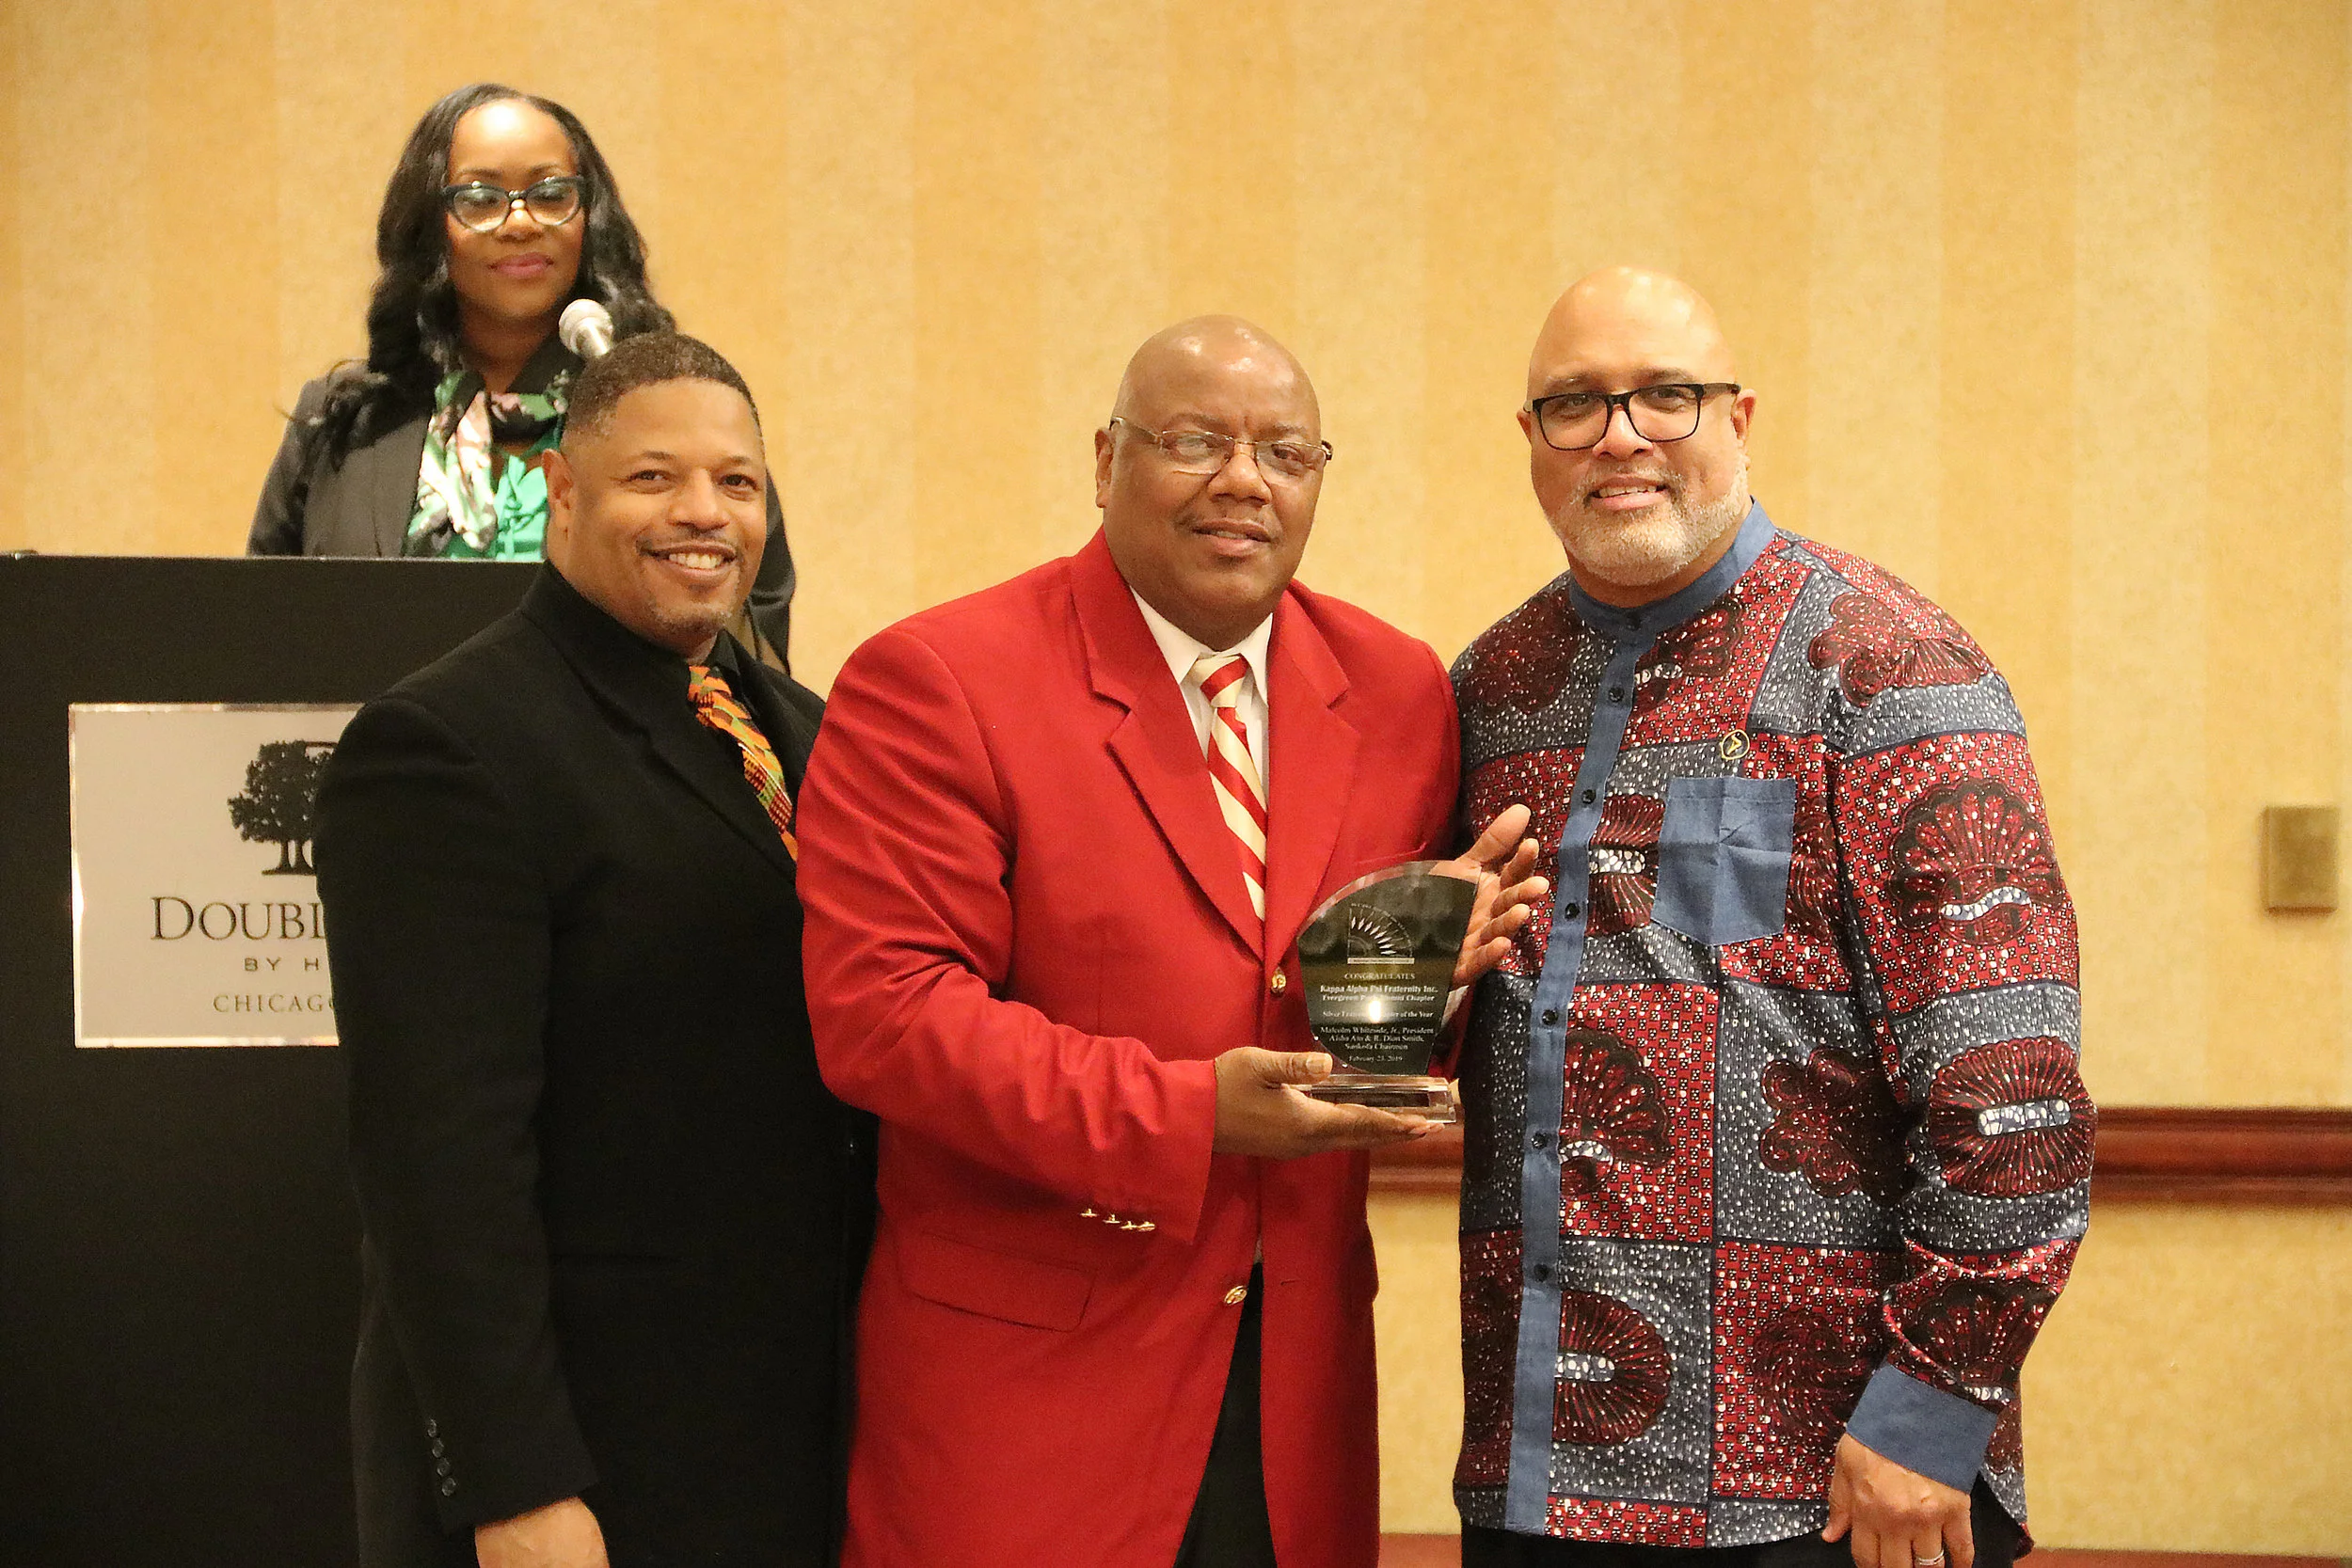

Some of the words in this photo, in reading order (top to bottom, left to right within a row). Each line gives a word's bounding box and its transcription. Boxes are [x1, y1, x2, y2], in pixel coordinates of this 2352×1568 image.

[245, 958, 281, 972] BY
[1320, 985, 1345, 993] Kappa
[1346, 985, 1368, 993] Alpha
[1384, 985, 1421, 995] Fraternity
[1406, 994, 1435, 1003] Chapter
